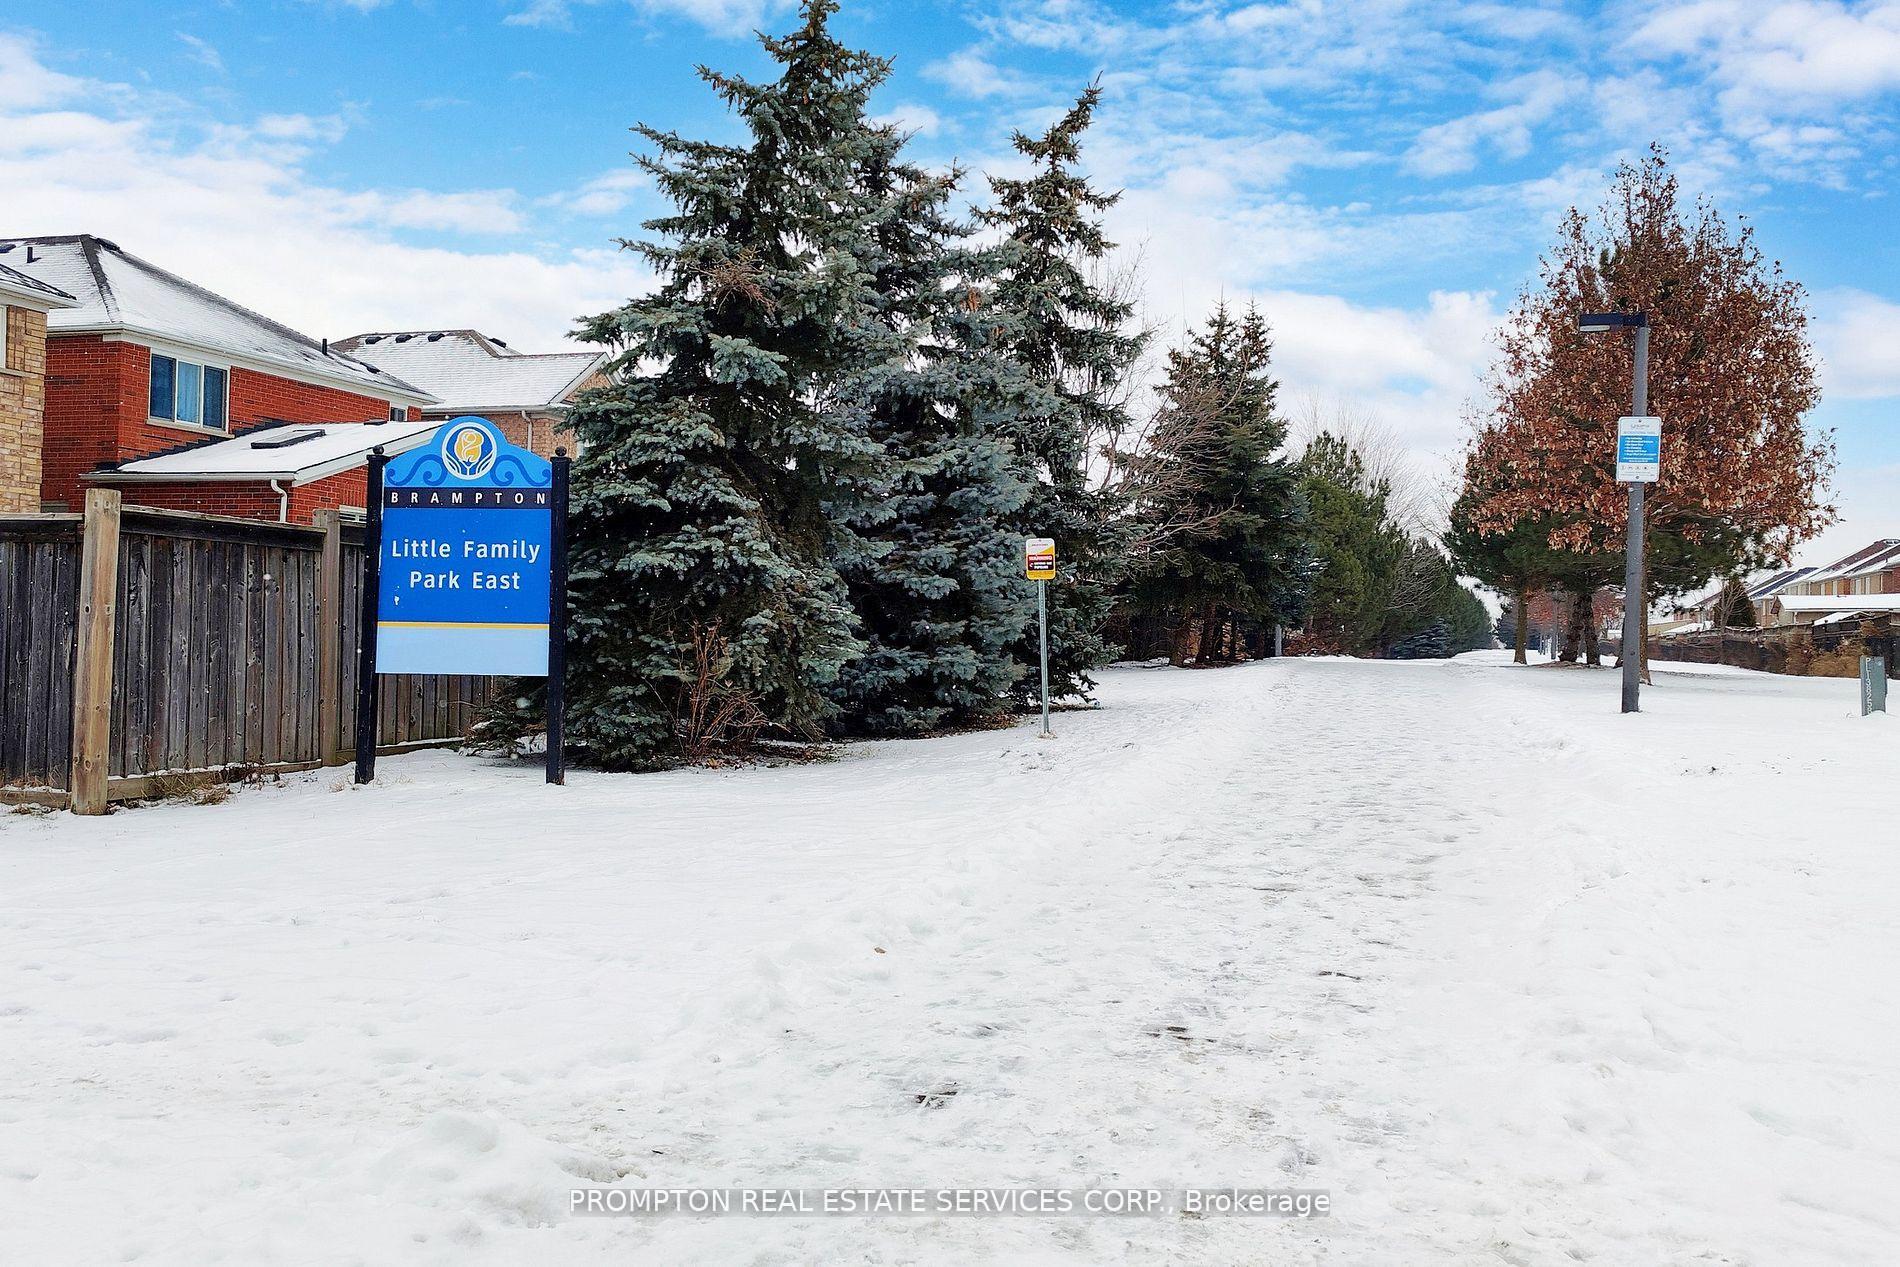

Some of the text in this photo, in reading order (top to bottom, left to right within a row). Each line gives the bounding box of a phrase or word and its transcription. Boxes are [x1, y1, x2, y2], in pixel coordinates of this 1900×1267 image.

[391, 492, 546, 504] BRAMPTON
[392, 538, 541, 564] Little Family
[410, 571, 521, 590] Park East
